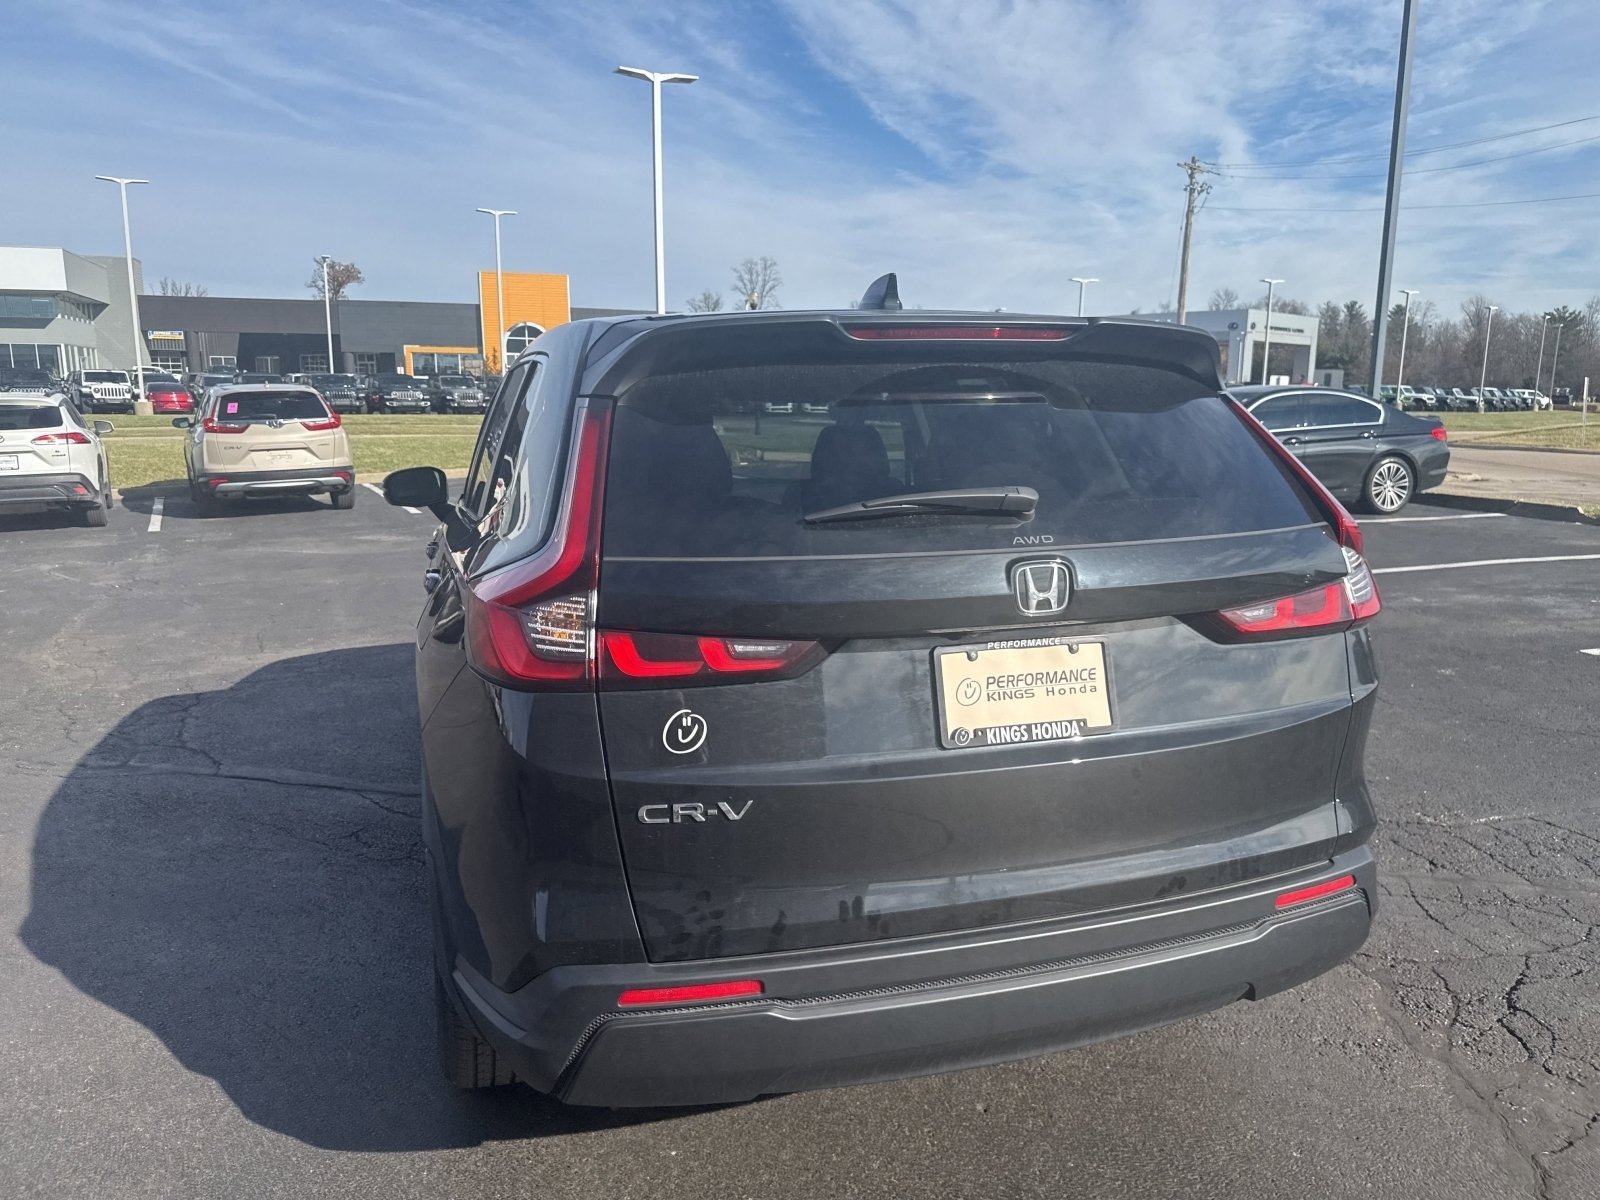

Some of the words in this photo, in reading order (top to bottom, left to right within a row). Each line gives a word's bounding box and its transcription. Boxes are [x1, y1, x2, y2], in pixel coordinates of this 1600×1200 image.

[1013, 535, 1054, 545] AWD
[987, 637, 1061, 650] PERFORMANCE
[986, 667, 1097, 689] PERFORMANCE
[987, 688, 1035, 702] KINGS
[1046, 684, 1097, 697] Honda
[986, 725, 1028, 744] KINGS
[1031, 720, 1080, 740] HONDA
[637, 799, 754, 824] CR-V
